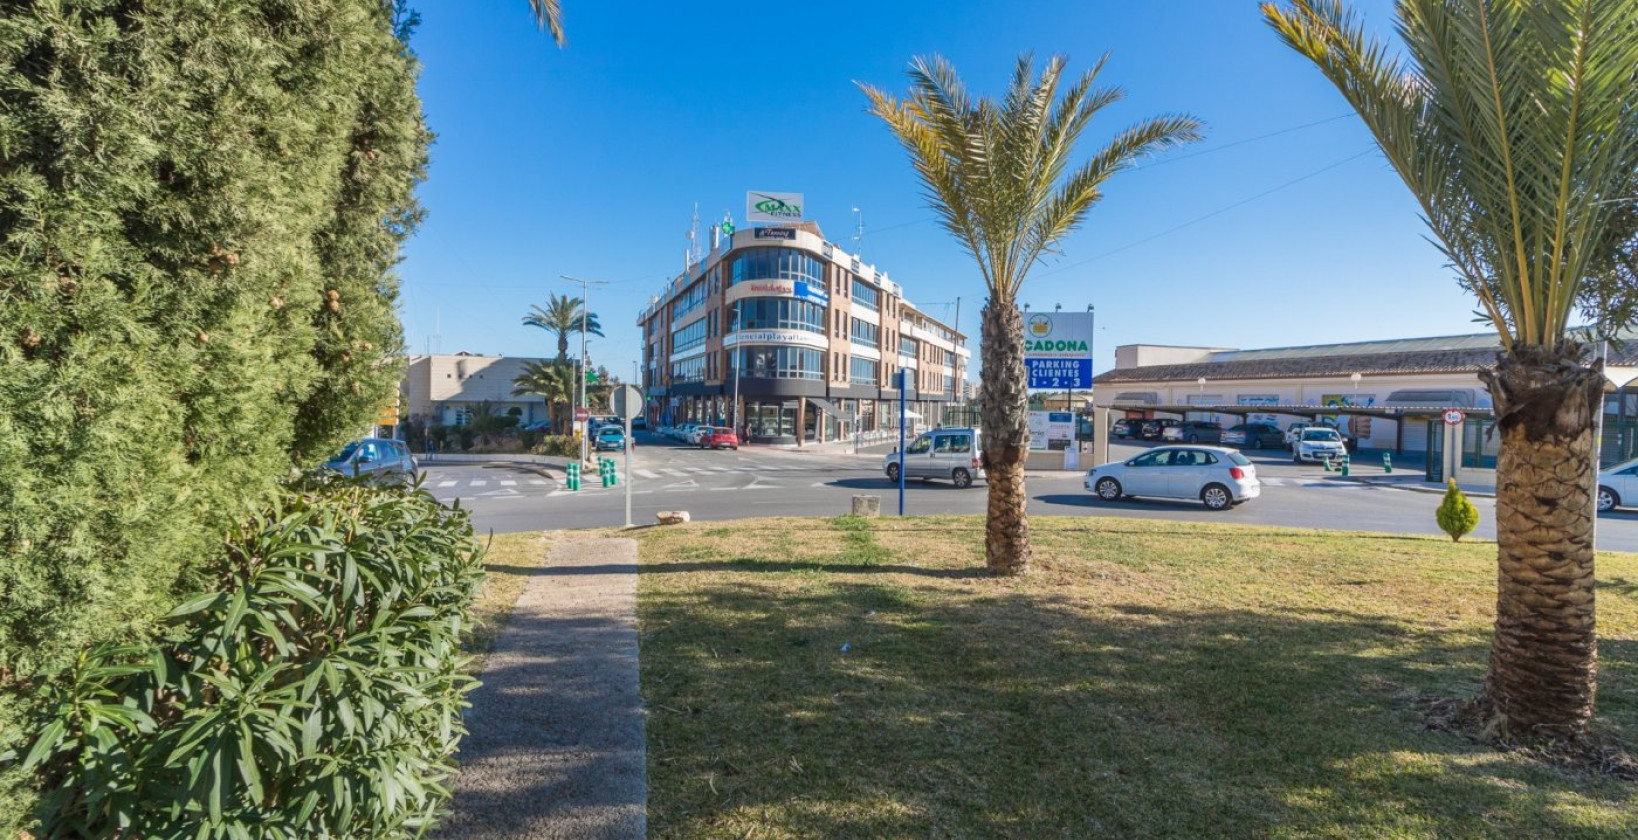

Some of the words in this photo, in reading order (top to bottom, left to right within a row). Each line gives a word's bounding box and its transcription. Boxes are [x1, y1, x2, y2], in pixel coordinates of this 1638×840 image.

[1025, 340, 1088, 351] CADONA
[1032, 360, 1080, 369] PARKING
[1032, 369, 1080, 378] CLIENTES
[1031, 377, 1037, 387] 1
[1052, 377, 1060, 387] 2
[1073, 377, 1081, 387] 3
